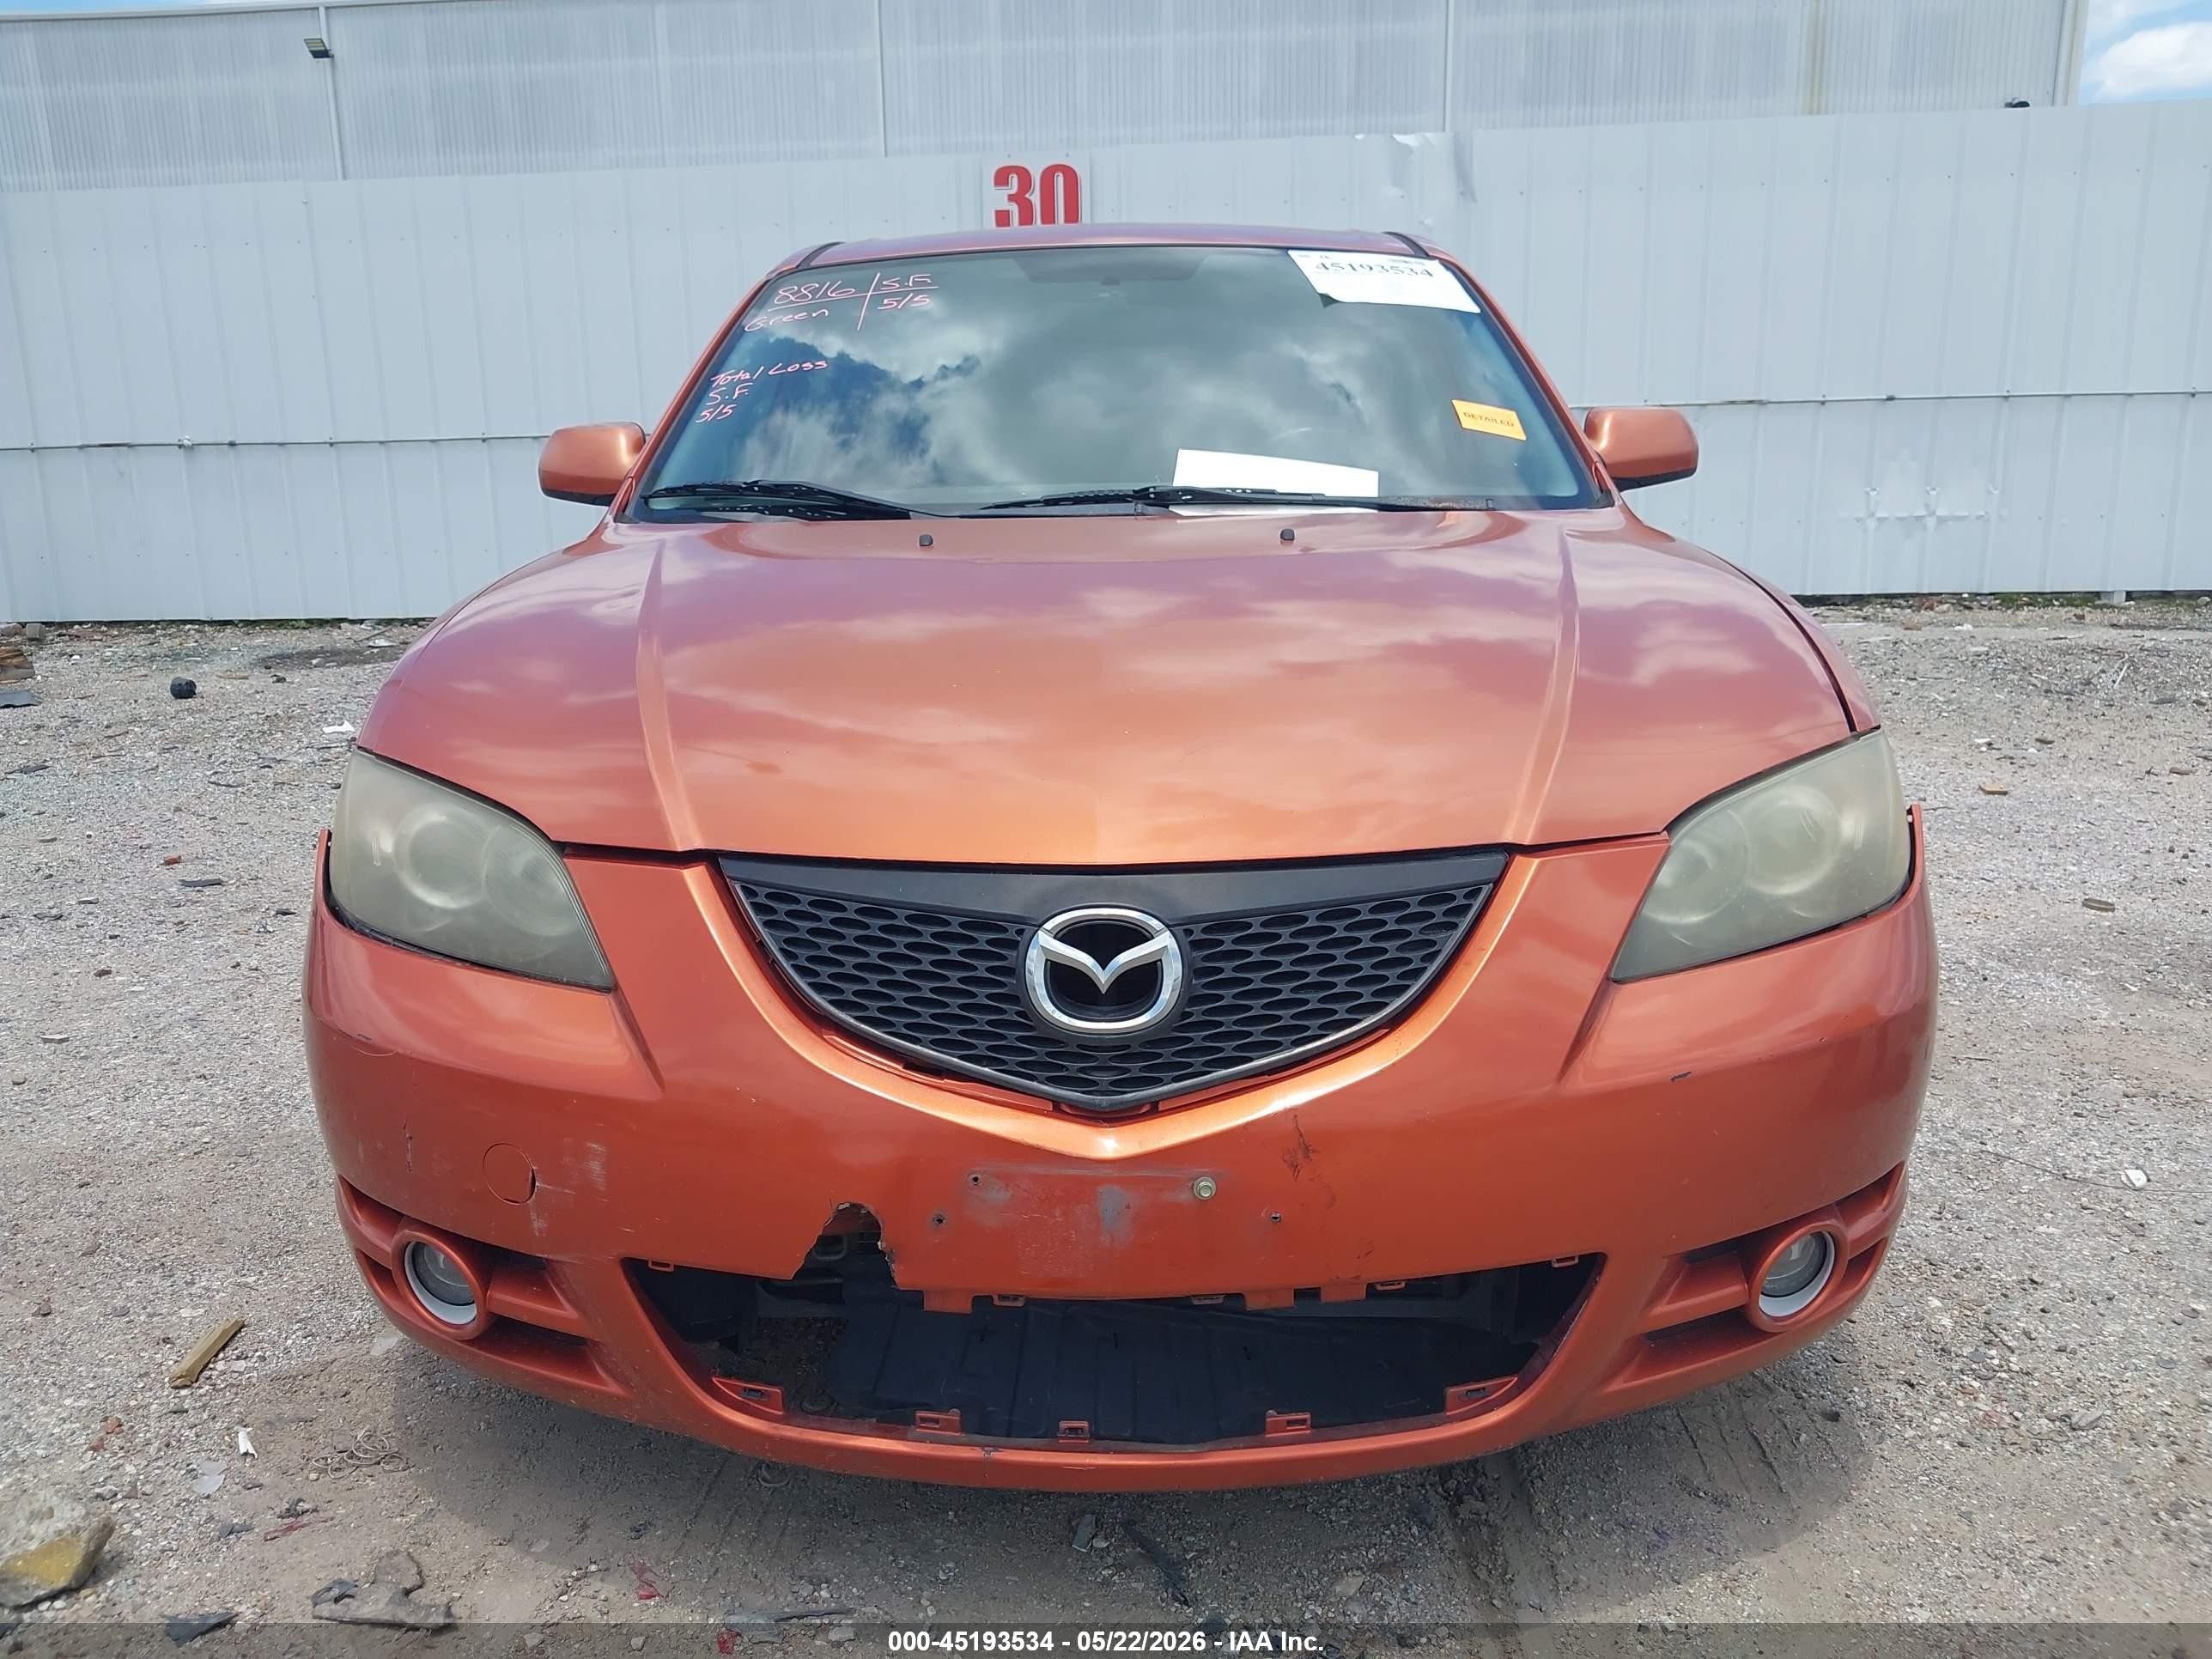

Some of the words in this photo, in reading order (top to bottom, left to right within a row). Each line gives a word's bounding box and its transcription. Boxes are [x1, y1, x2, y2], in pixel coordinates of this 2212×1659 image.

[994, 162, 1080, 228] 30
[1316, 261, 1433, 276] 45193534
[878, 293, 930, 310] 5/5
[710, 365, 764, 388] Total
[769, 360, 829, 375] Loss
[695, 404, 737, 423] 5/5
